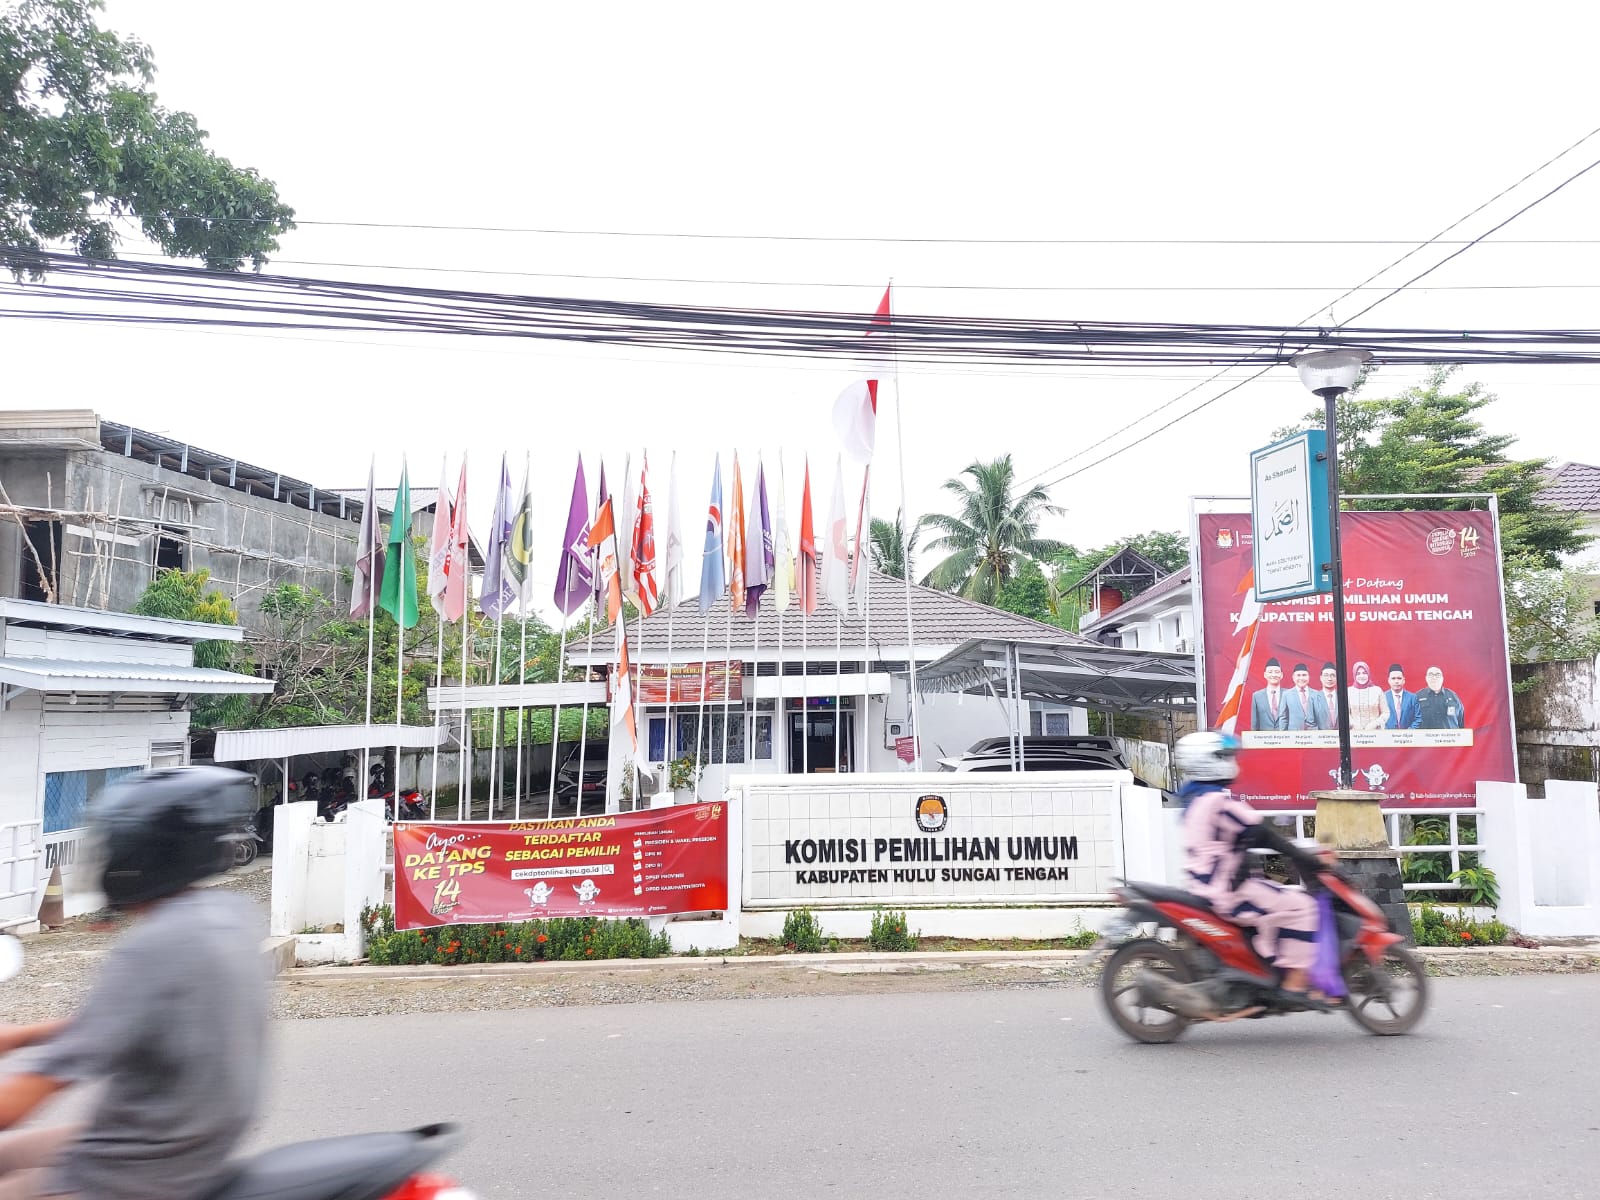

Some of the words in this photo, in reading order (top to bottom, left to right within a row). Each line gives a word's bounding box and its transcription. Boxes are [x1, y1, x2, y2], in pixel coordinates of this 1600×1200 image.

[1458, 526, 1480, 549] 14
[1356, 577, 1404, 590] Datang
[1324, 593, 1401, 605] PMILIHAN
[1404, 593, 1449, 604] UMUM
[1230, 612, 1315, 623] KUPATEN
[1360, 610, 1412, 621] SUNGAI
[1415, 609, 1473, 620] TENGAH
[509, 820, 574, 832] PASTIKAN
[577, 817, 616, 828] ANDA
[523, 832, 602, 846] TERDAFTAR
[405, 845, 492, 868] DATANG
[505, 848, 563, 862] SEBAGAI
[566, 844, 621, 858] PEMILIH
[785, 838, 867, 864] KOMISI
[874, 836, 1000, 863] PEMILIHAN
[1007, 835, 1079, 860] UMUM
[413, 866, 442, 881] KE
[447, 861, 486, 877] TPS
[514, 866, 599, 878] cekdptonline.kpu.go.id
[796, 869, 888, 885] KABUPATEN
[893, 868, 936, 883] HULU
[941, 867, 1000, 882] SUNGAI
[1004, 866, 1069, 881] TENGAH
[434, 878, 462, 905] 14
